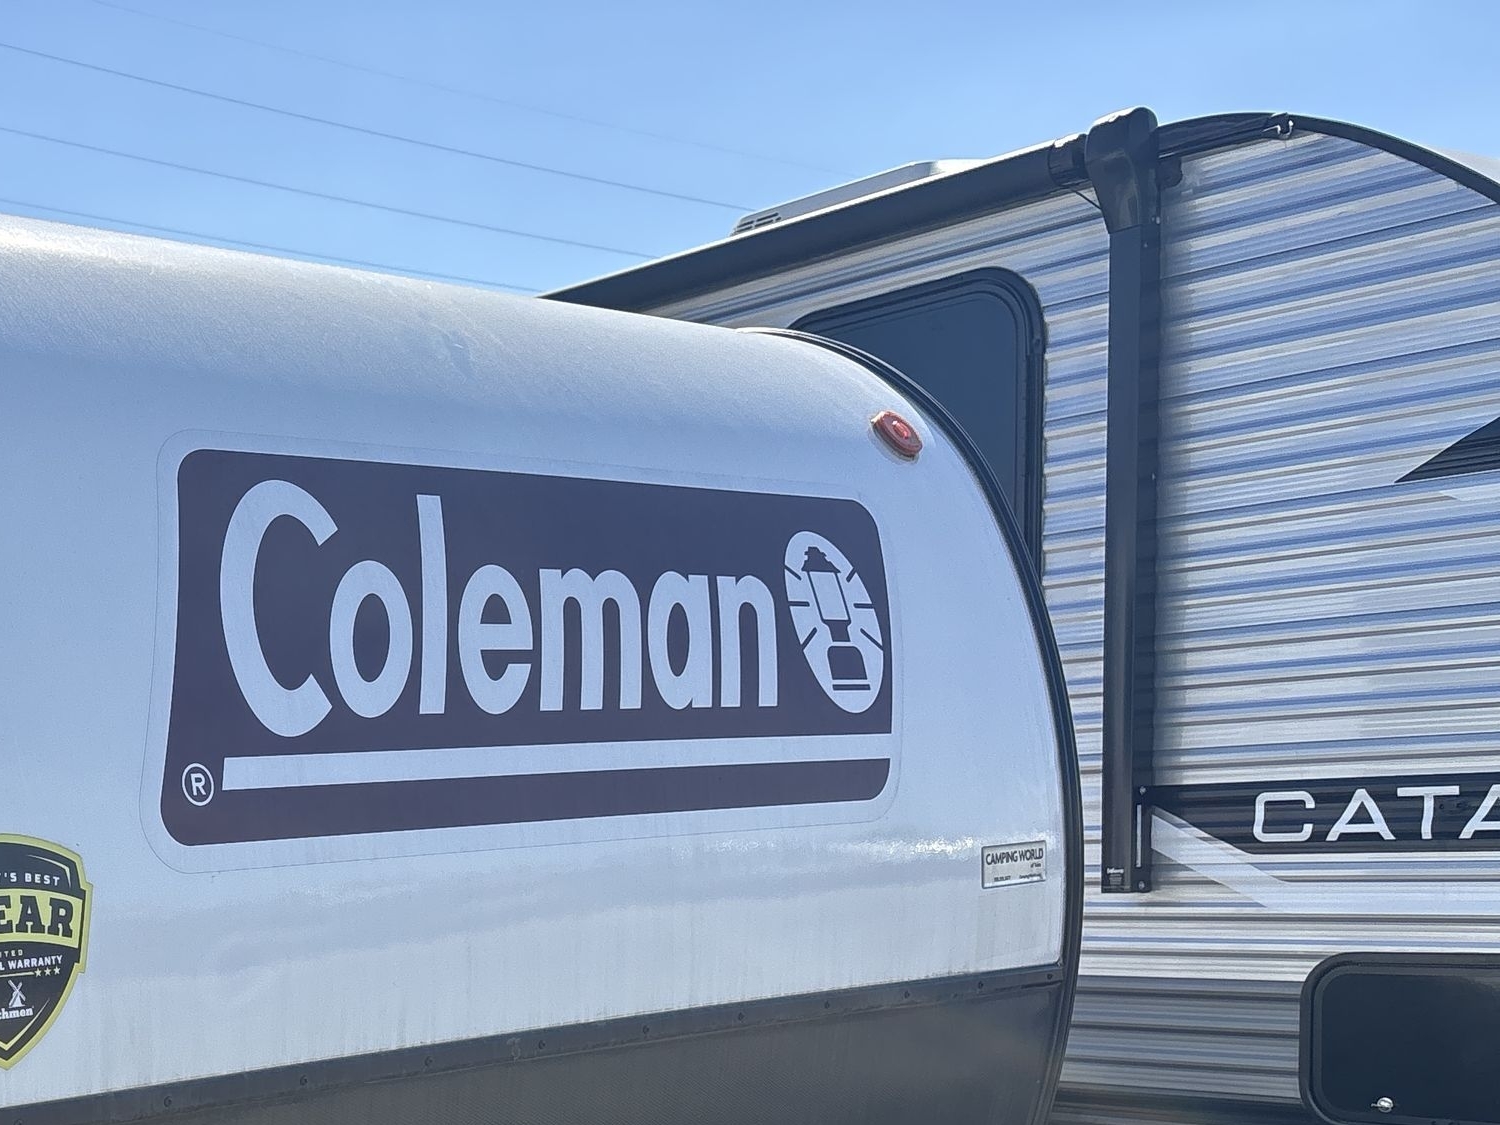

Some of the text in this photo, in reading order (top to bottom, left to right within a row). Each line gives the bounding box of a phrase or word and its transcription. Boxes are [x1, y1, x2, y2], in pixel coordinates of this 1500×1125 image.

[219, 480, 778, 737] Coleman
[1253, 784, 1500, 842] CATA
[986, 848, 1043, 865] CAMPING WORLD
[25, 873, 60, 886] BEST
[8, 954, 63, 970] WARRANTY
